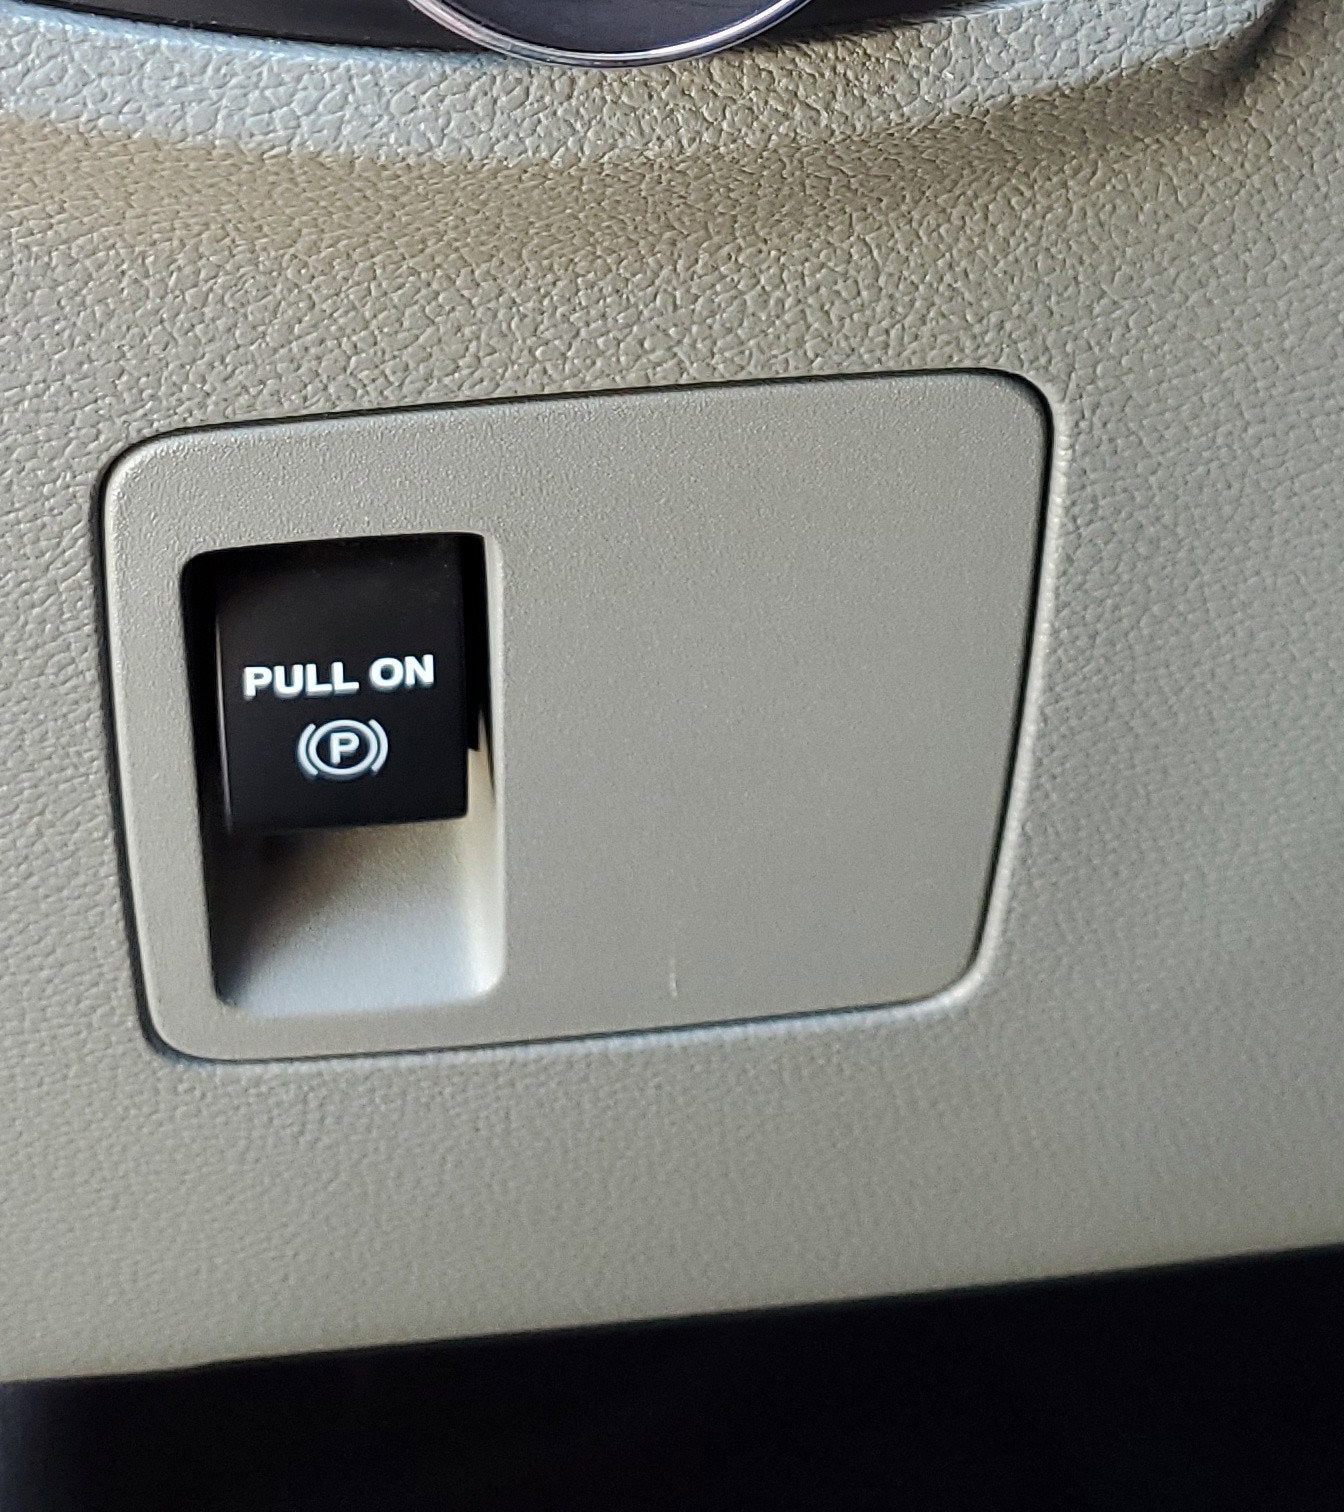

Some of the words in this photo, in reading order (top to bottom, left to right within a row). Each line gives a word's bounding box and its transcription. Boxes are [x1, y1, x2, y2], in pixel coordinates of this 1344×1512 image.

[243, 661, 359, 700] PULL
[369, 654, 434, 690] ON
[329, 731, 360, 765] P
